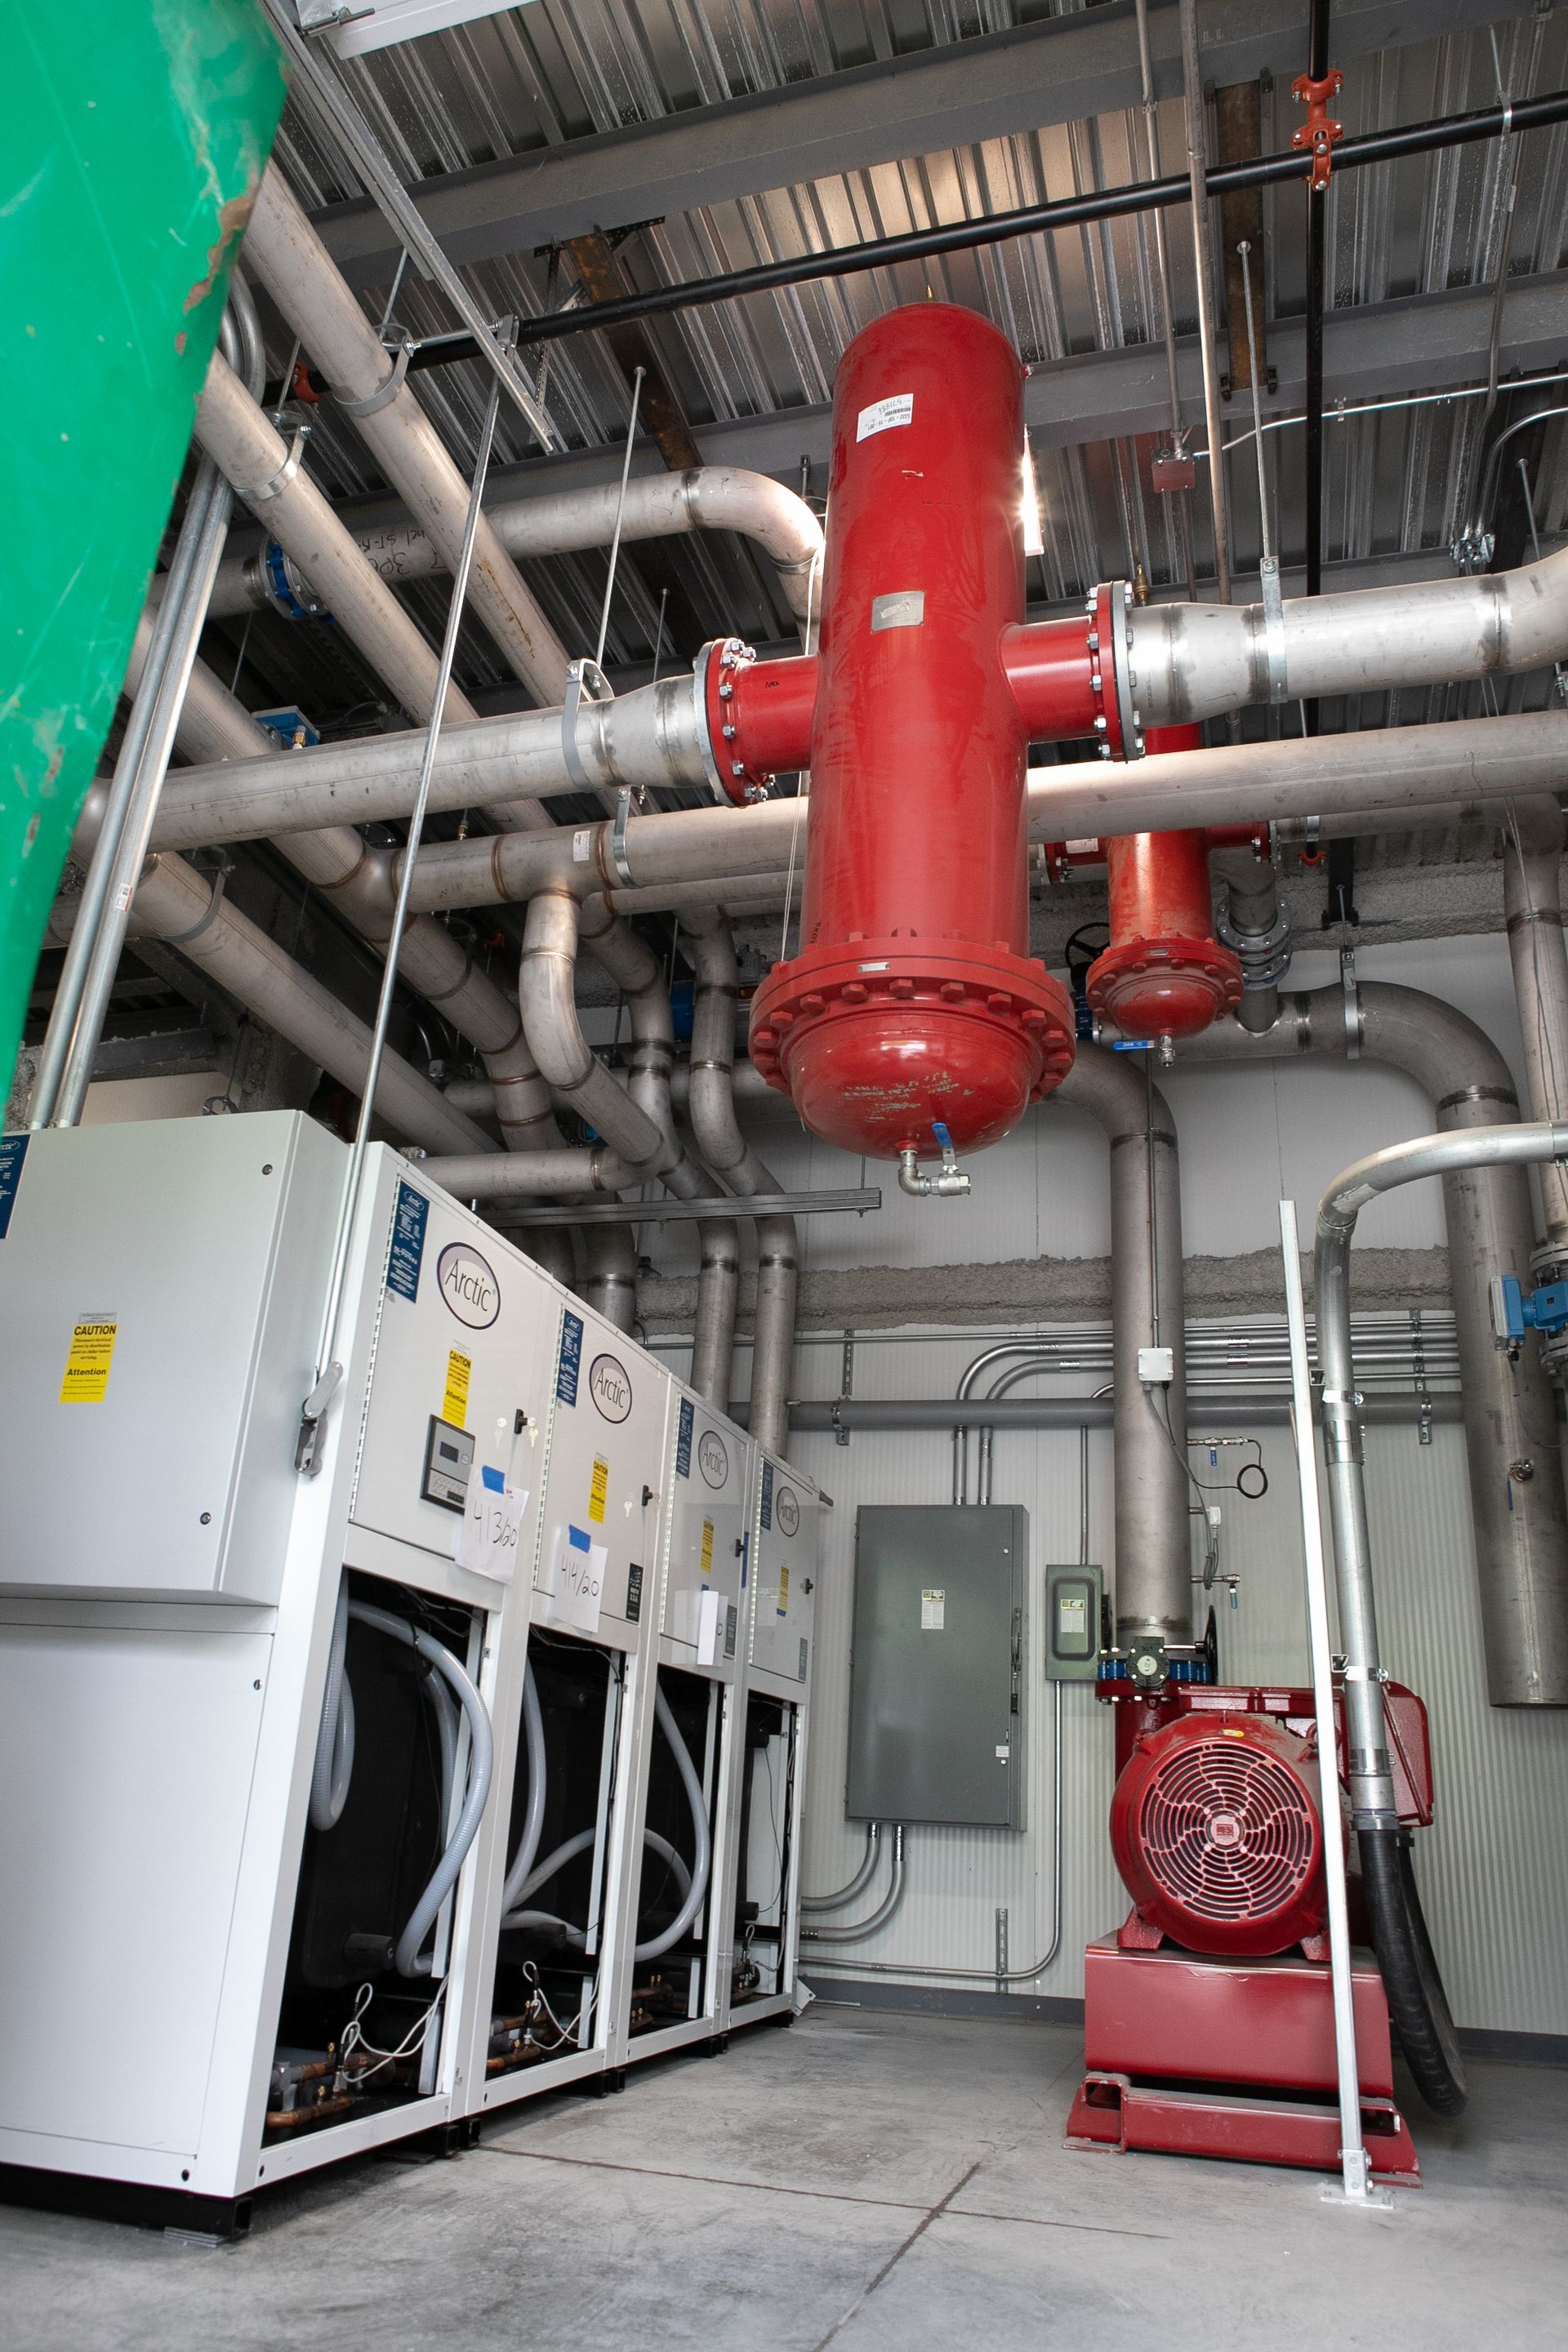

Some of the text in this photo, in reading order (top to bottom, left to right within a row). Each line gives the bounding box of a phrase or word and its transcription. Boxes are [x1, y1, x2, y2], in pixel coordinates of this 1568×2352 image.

[444, 1258, 492, 1312] Arctic
[74, 1325, 117, 1335] CAUTION
[67, 1368, 107, 1376] Attention
[449, 1350, 472, 1370] CAUTION
[446, 1389, 466, 1405] Attention
[594, 1366, 626, 1409] Arctic
[701, 1441, 724, 1477] Arctic
[561, 1555, 599, 1597] 414/20
